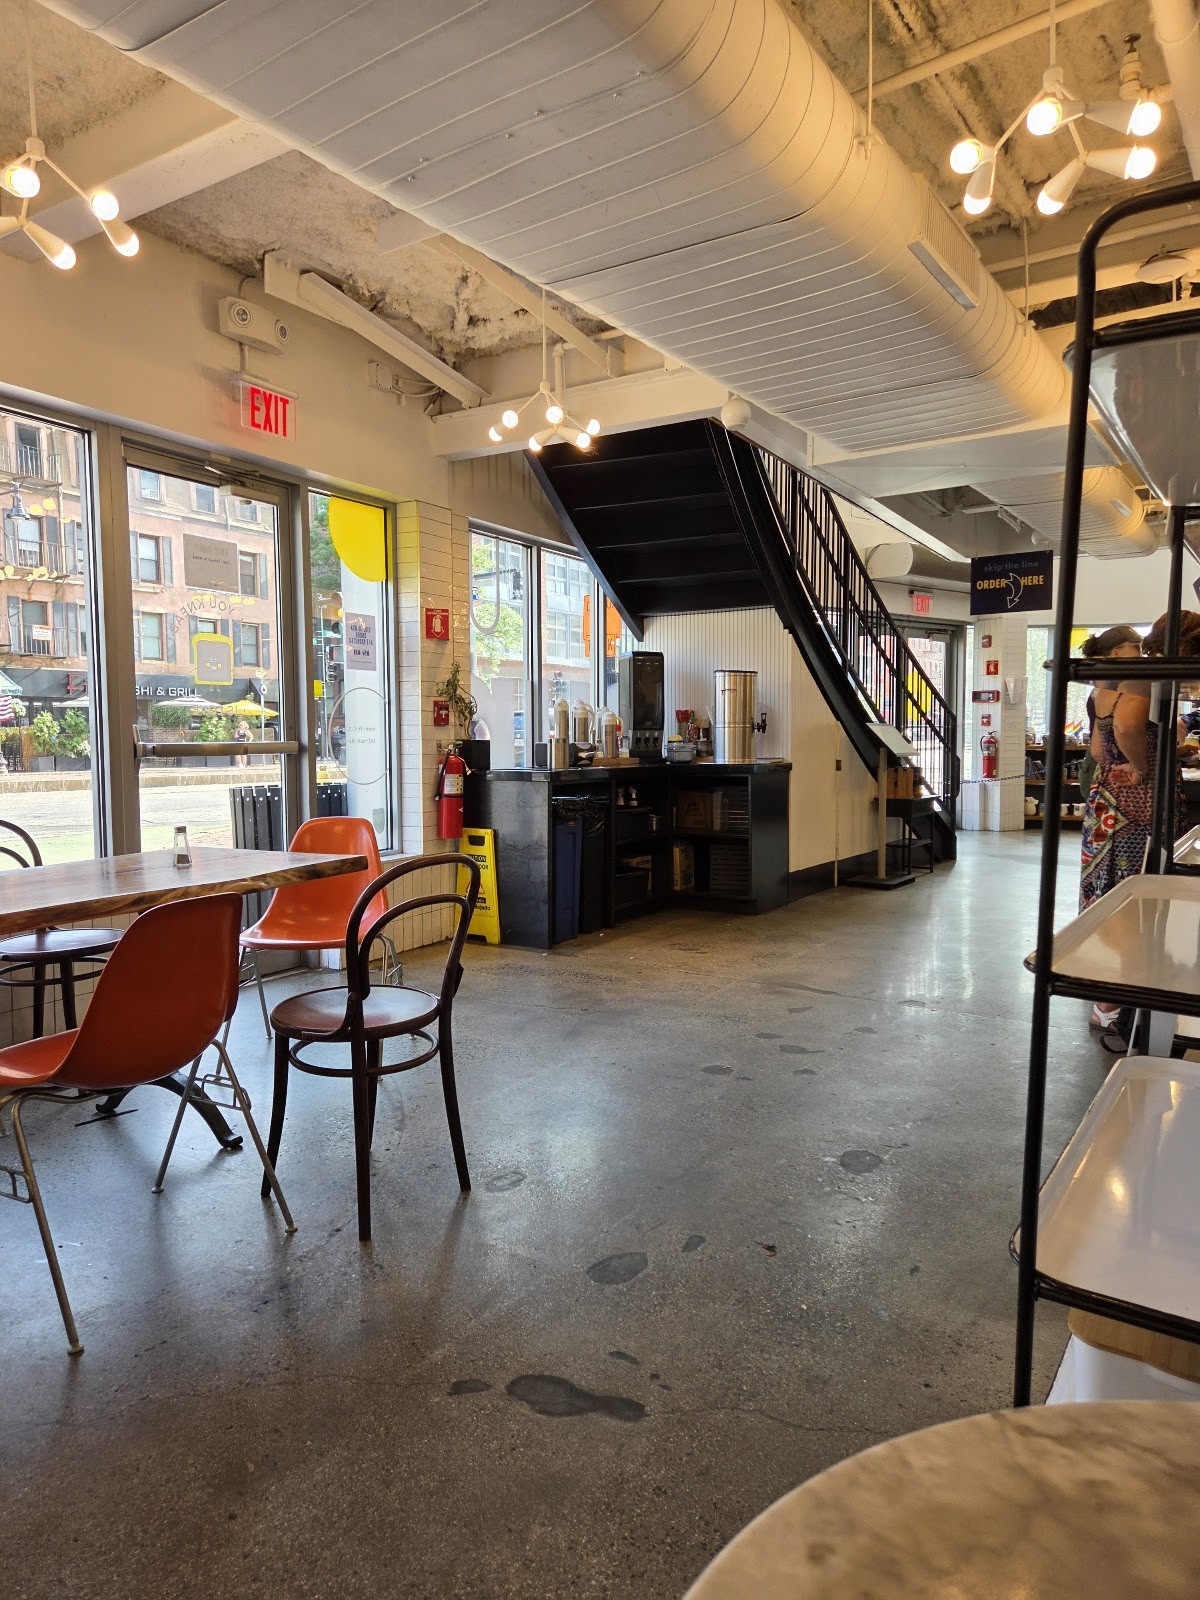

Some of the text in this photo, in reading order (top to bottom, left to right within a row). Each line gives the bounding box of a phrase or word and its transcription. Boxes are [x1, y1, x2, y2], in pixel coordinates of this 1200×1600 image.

[250, 386, 289, 437] EXIT
[983, 560, 1039, 573] skip the line
[976, 575, 1045, 590] ORDER HERE
[916, 595, 931, 613] EXIT
[156, 686, 166, 696] &
[168, 687, 202, 697] GRILL
